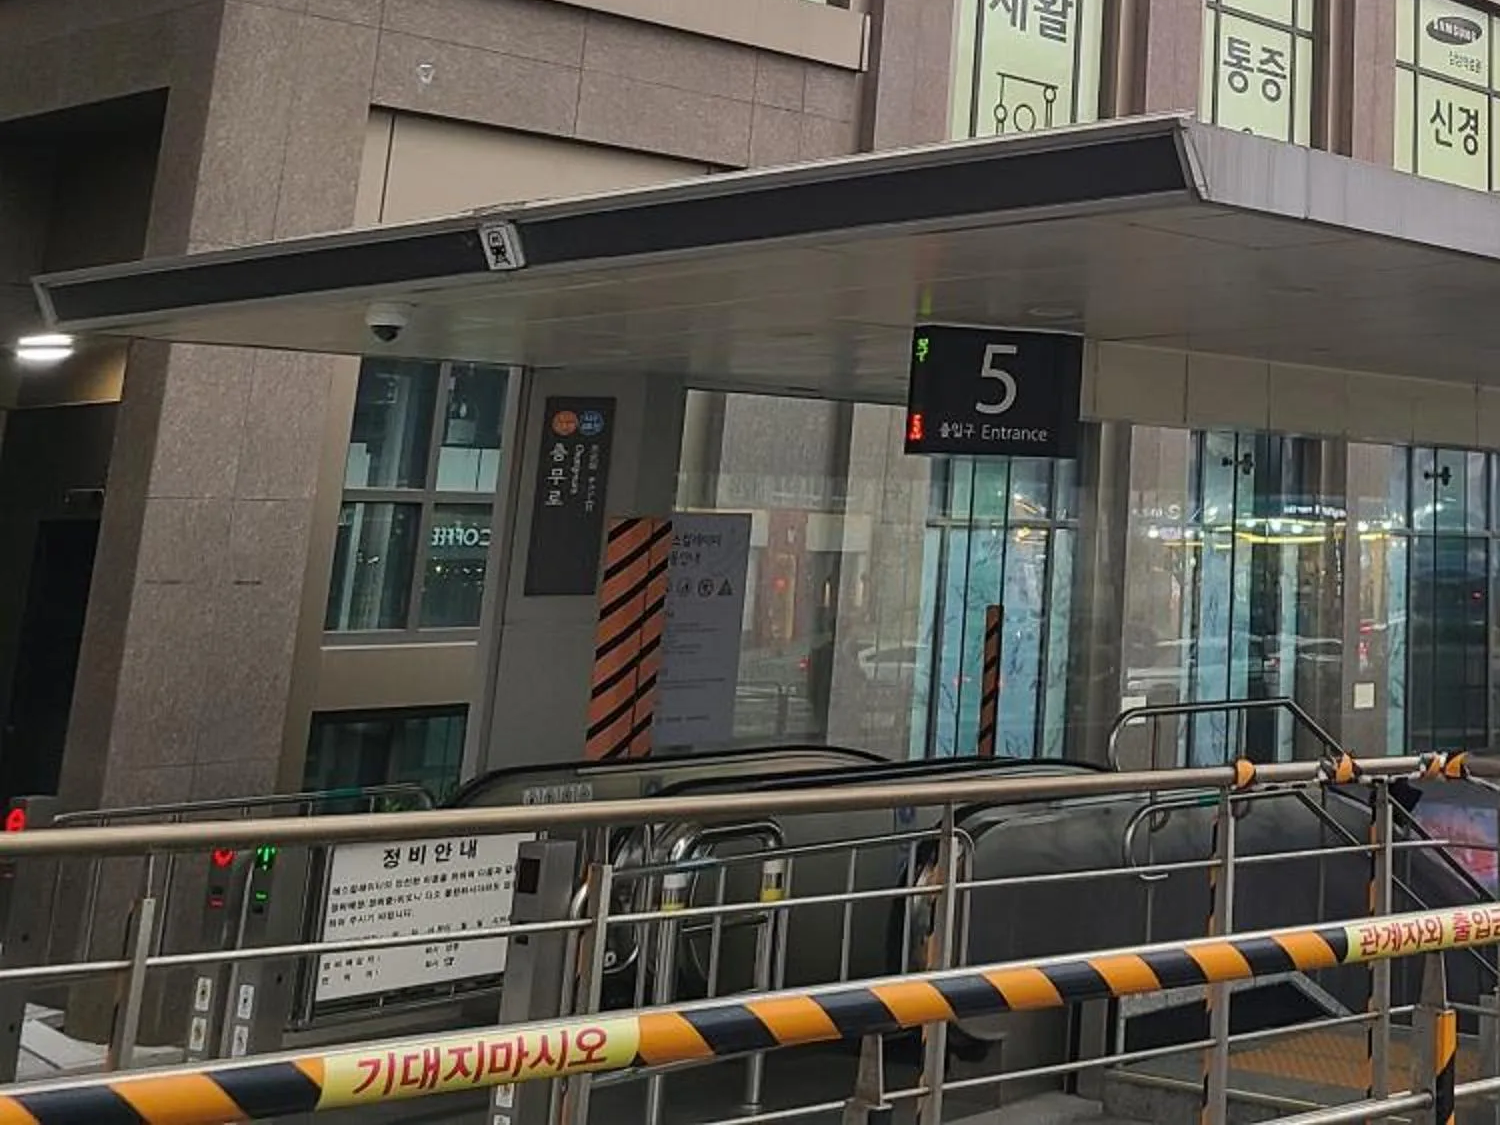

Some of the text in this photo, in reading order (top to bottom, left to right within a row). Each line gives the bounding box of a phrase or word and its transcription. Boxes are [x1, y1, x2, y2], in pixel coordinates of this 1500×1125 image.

[1223, 36, 1287, 103] 통증
[1430, 99, 1479, 156] 신경
[975, 344, 1018, 415] 5
[981, 424, 1049, 442] Entrance
[383, 839, 478, 869] 정비안내
[1360, 916, 1444, 956] 관계자외
[352, 1027, 607, 1096] 기대지마시오
